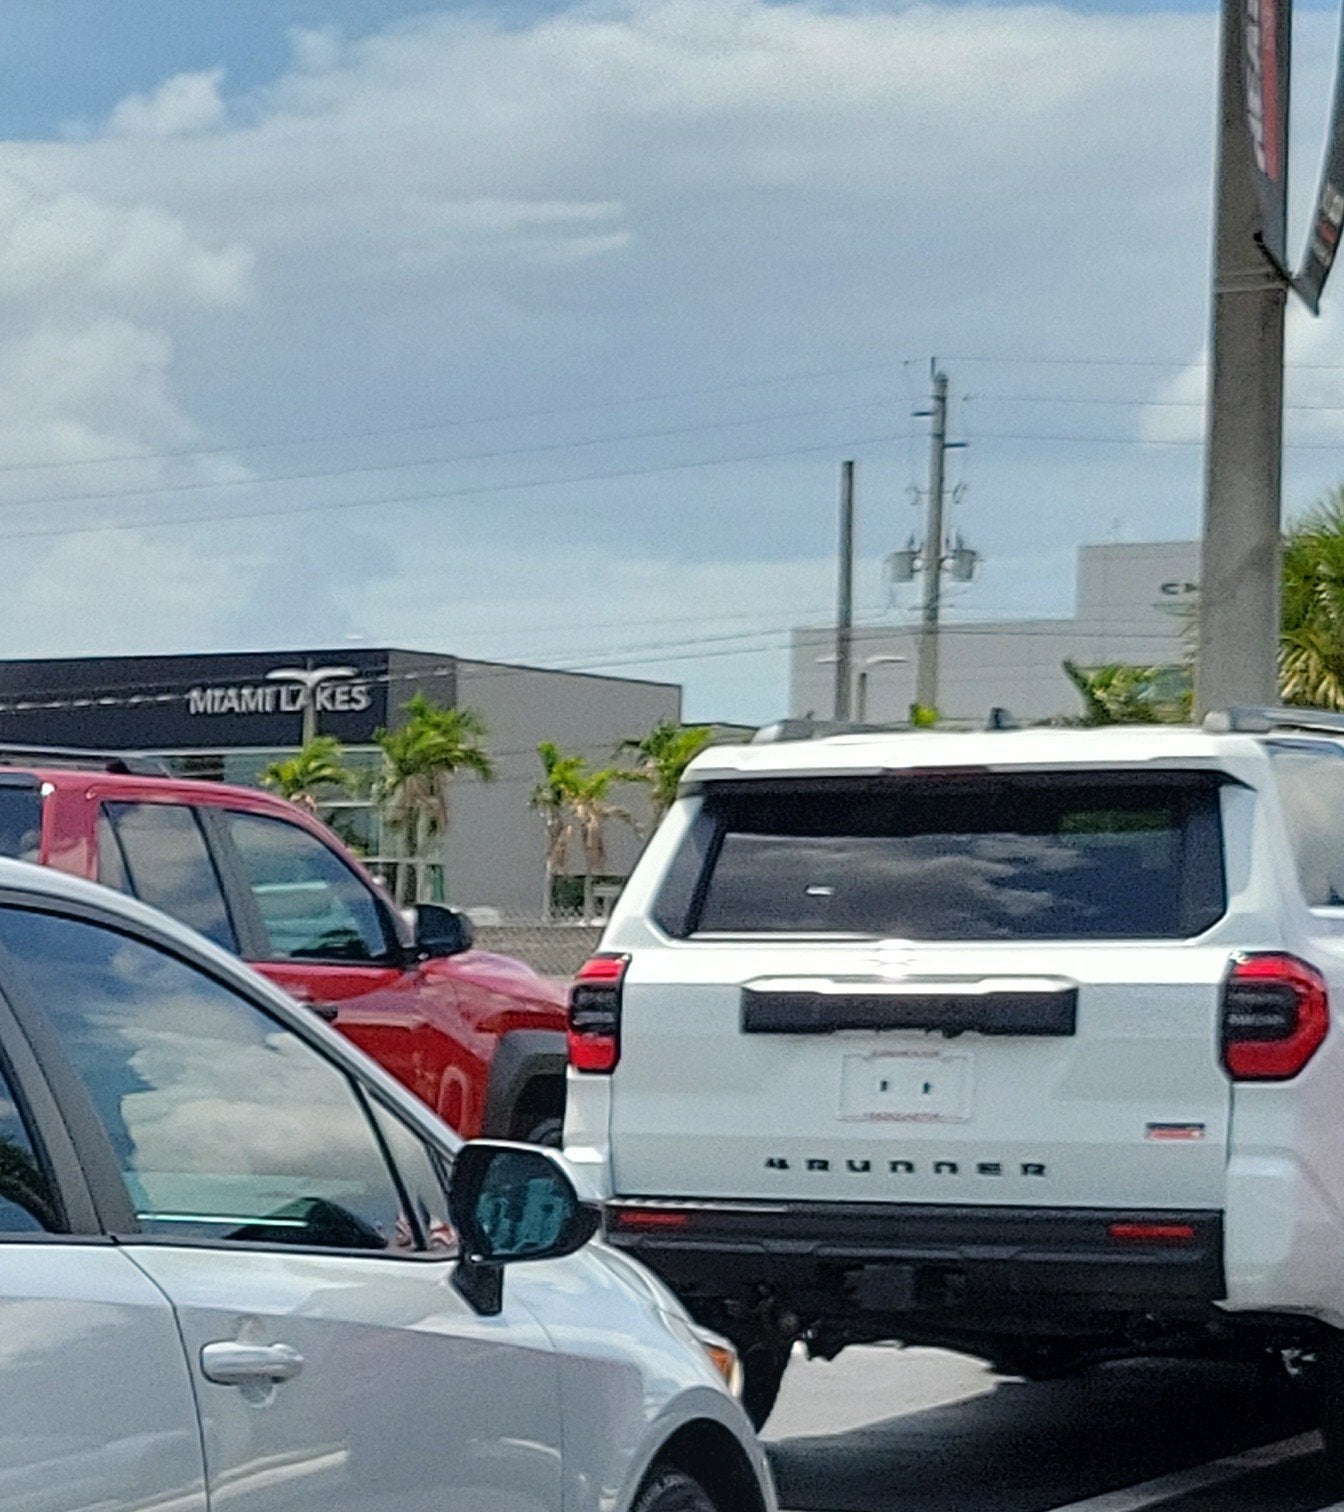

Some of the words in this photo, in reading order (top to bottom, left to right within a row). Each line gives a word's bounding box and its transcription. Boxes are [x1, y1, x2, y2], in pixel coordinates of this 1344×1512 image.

[186, 685, 276, 715] MIAMI
[278, 684, 372, 712] LAKES
[765, 1158, 1046, 1176] 4RUNNER
